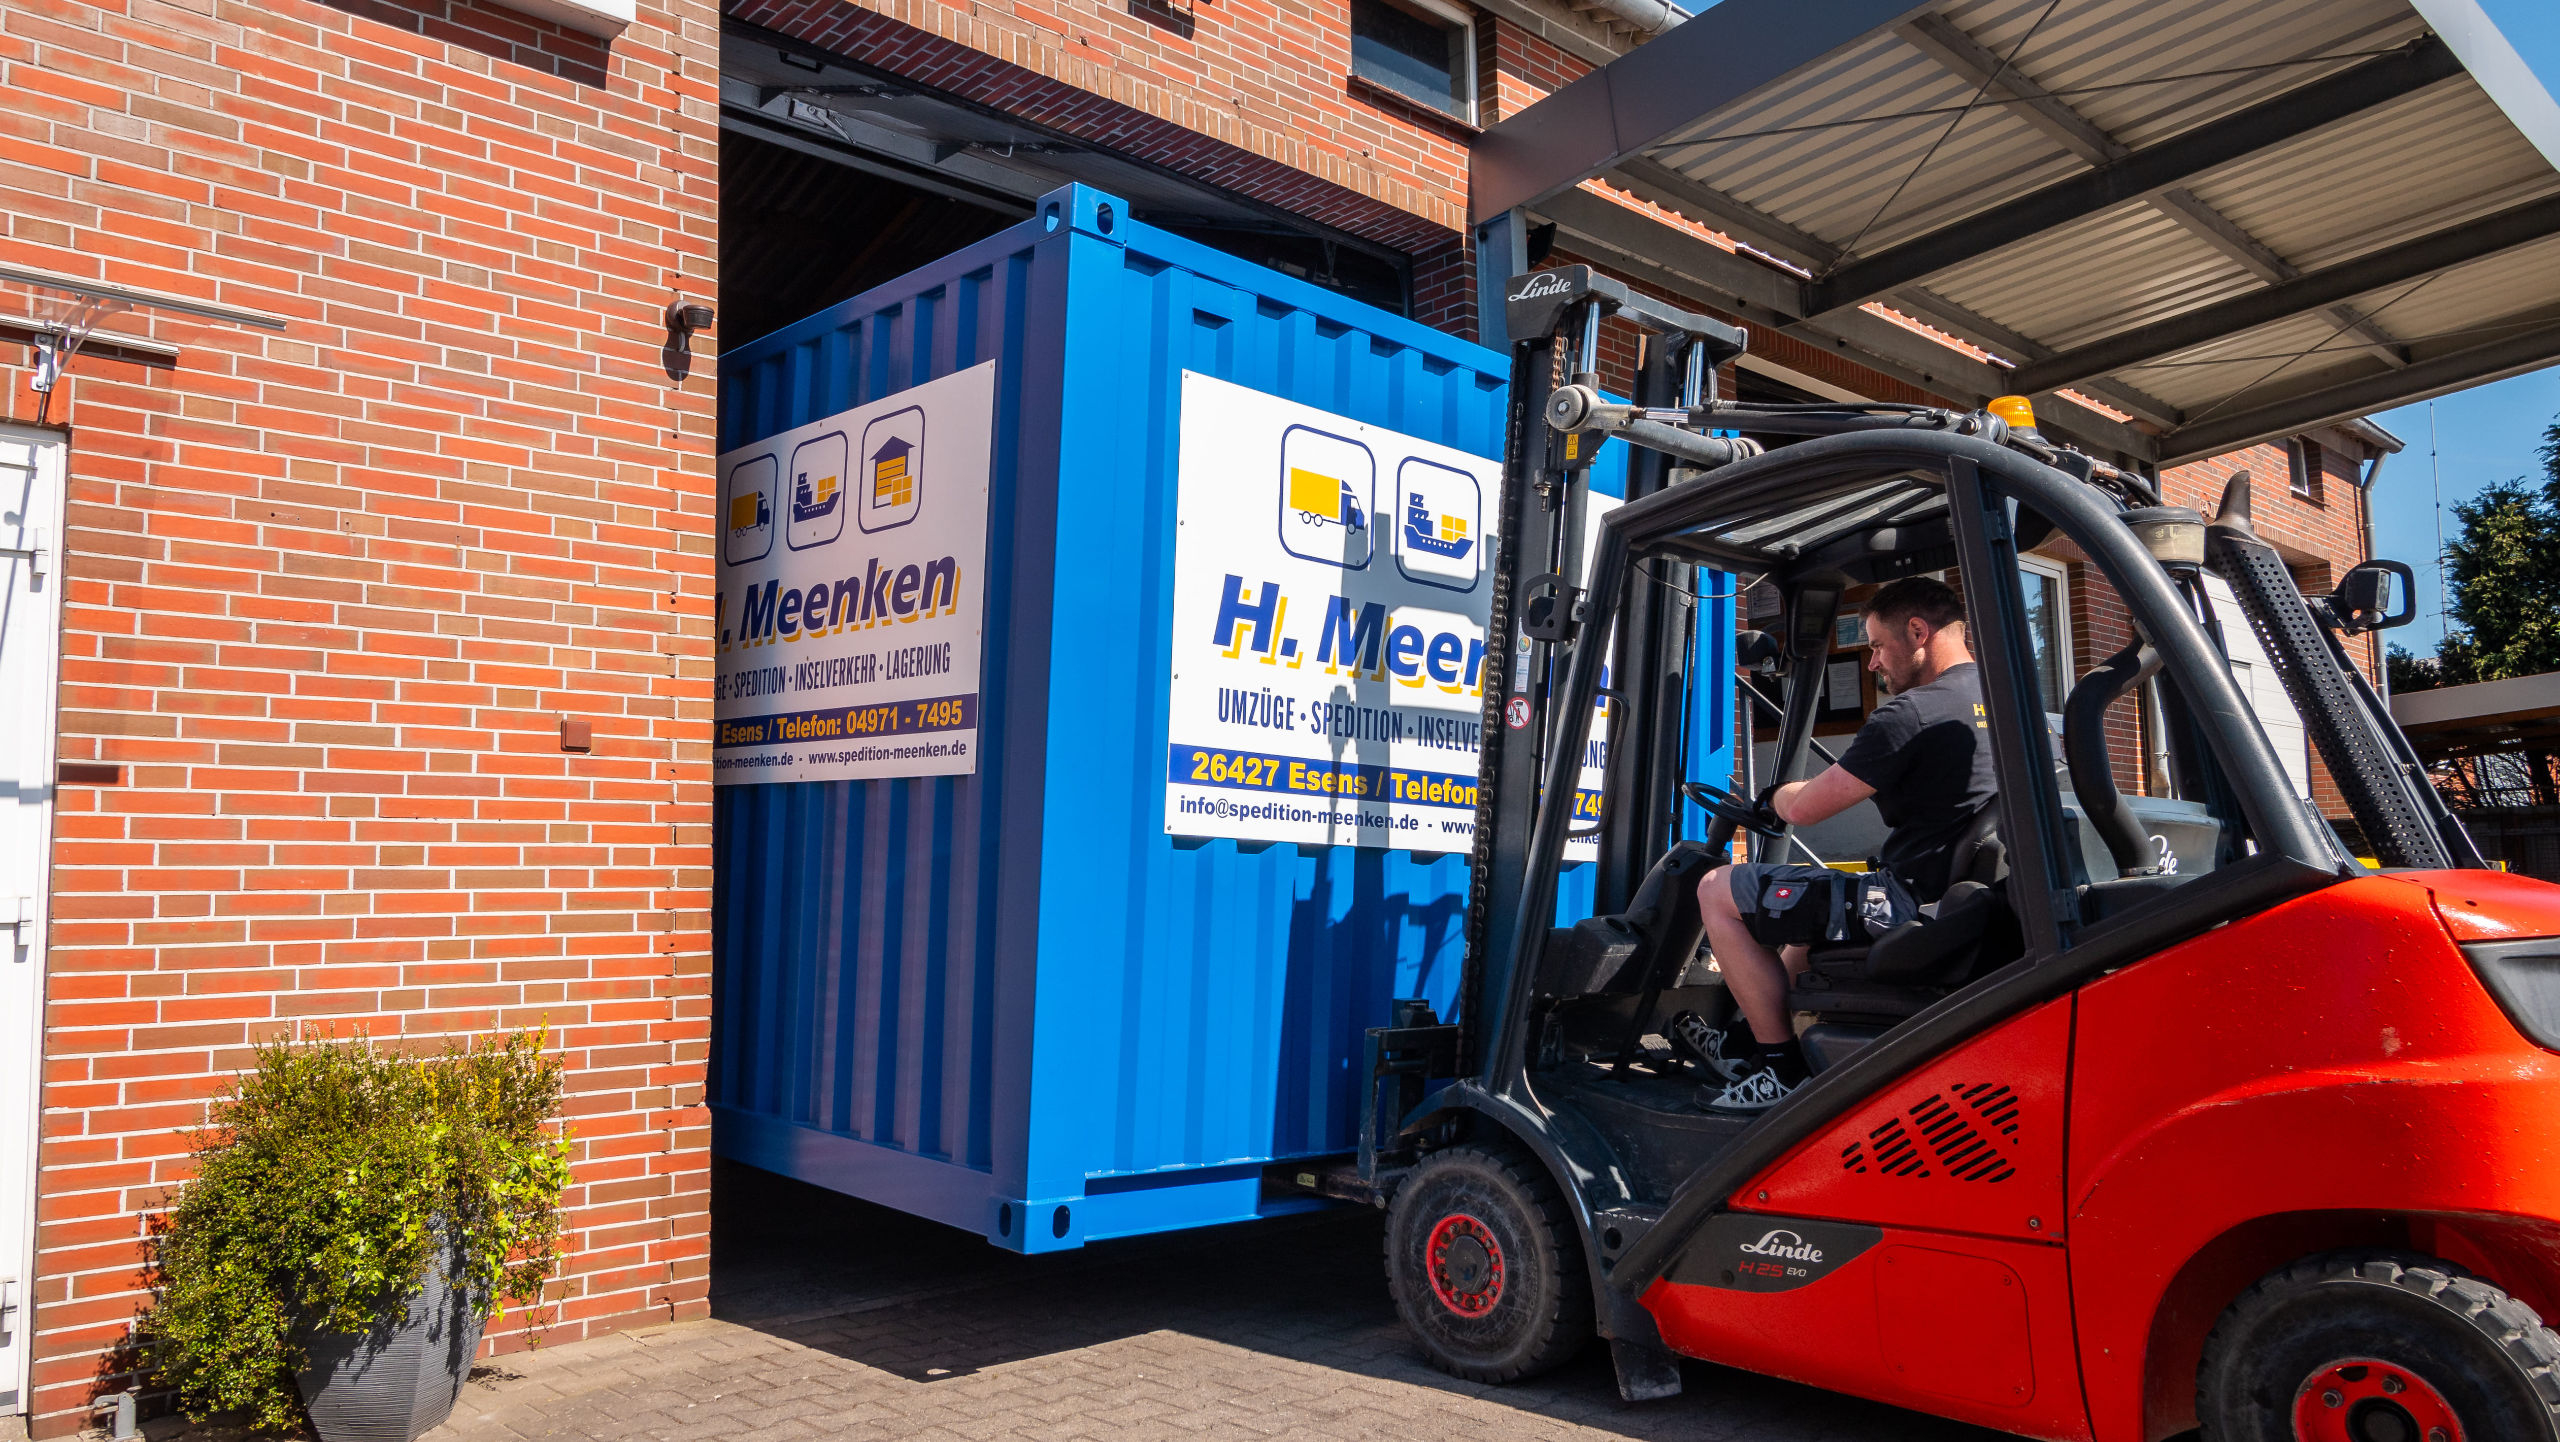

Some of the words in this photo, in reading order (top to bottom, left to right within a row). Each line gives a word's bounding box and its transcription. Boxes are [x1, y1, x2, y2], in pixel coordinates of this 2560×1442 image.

[1508, 273, 1571, 302] Linde
[739, 556, 959, 647] Meenken
[1213, 574, 1301, 665] H.
[734, 666, 787, 699] SPEDITION
[795, 653, 877, 691] INSELVERKEHR
[886, 641, 951, 681] LAGERUNG
[721, 722, 764, 745] Esens
[776, 711, 841, 740] Telefon:
[846, 706, 899, 734] 04971
[917, 699, 963, 729] 7495
[1218, 687, 1295, 731] UMZÜGE
[1311, 701, 1403, 744] SPEDITION
[1418, 716, 1481, 754] INSELVE
[713, 751, 794, 770] ition-meenken.de
[808, 740, 967, 766] www.spedition-meenken.de
[1191, 752, 1280, 787] 26427
[1288, 762, 1368, 796] Esens
[1180, 795, 1419, 831] info@spedition-meenken.de
[1740, 1229, 1824, 1263] Linde
[1786, 1267, 1807, 1277] EVO
